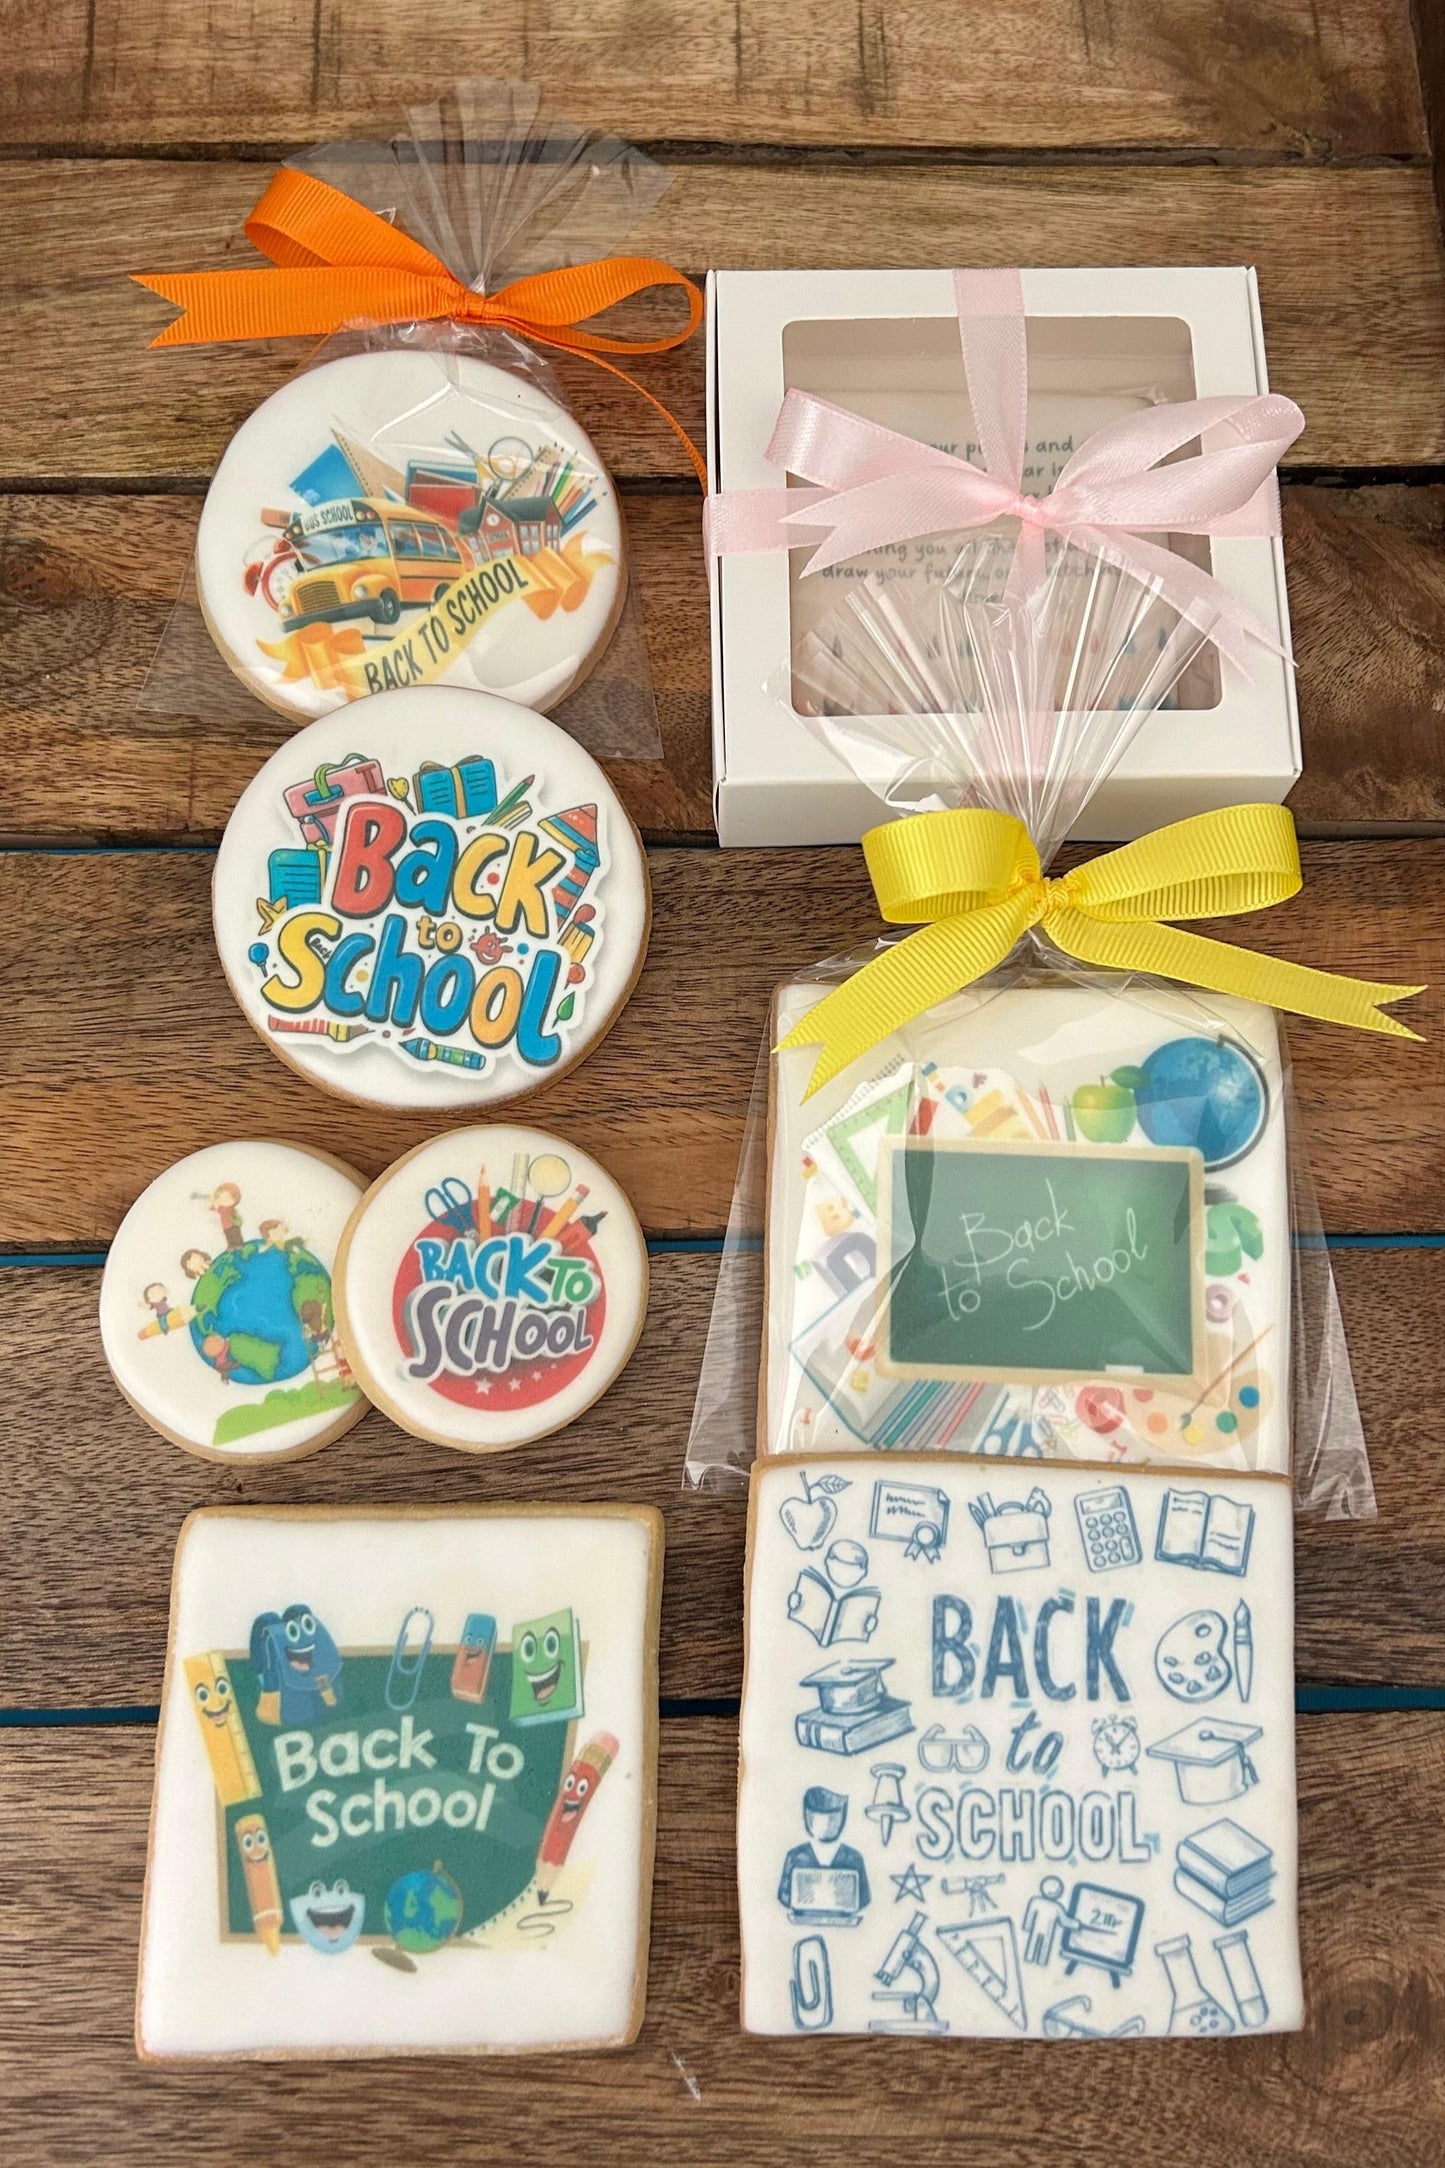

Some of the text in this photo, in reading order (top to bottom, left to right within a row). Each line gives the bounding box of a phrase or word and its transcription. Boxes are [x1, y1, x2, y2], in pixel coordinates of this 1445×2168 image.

[1037, 435, 1074, 453] and
[320, 504, 354, 525] SCHOOL
[915, 544, 946, 562] you
[822, 565, 868, 578] draw
[875, 569, 915, 585] your
[364, 559, 529, 695] BACK TO SCHOOL
[331, 802, 567, 938] Back
[416, 916, 463, 953] to
[260, 911, 562, 1066] School
[954, 1178, 1075, 1283] Back
[416, 1237, 593, 1304] BACK TO
[937, 1208, 1148, 1331] to School
[409, 1286, 593, 1378] SCHOOL
[932, 1593, 1132, 1702] BACK
[274, 1716, 525, 1793] Back To
[1005, 1711, 1064, 1776] to
[304, 1778, 497, 1848] School
[917, 1786, 1152, 1863] SCHOOL
